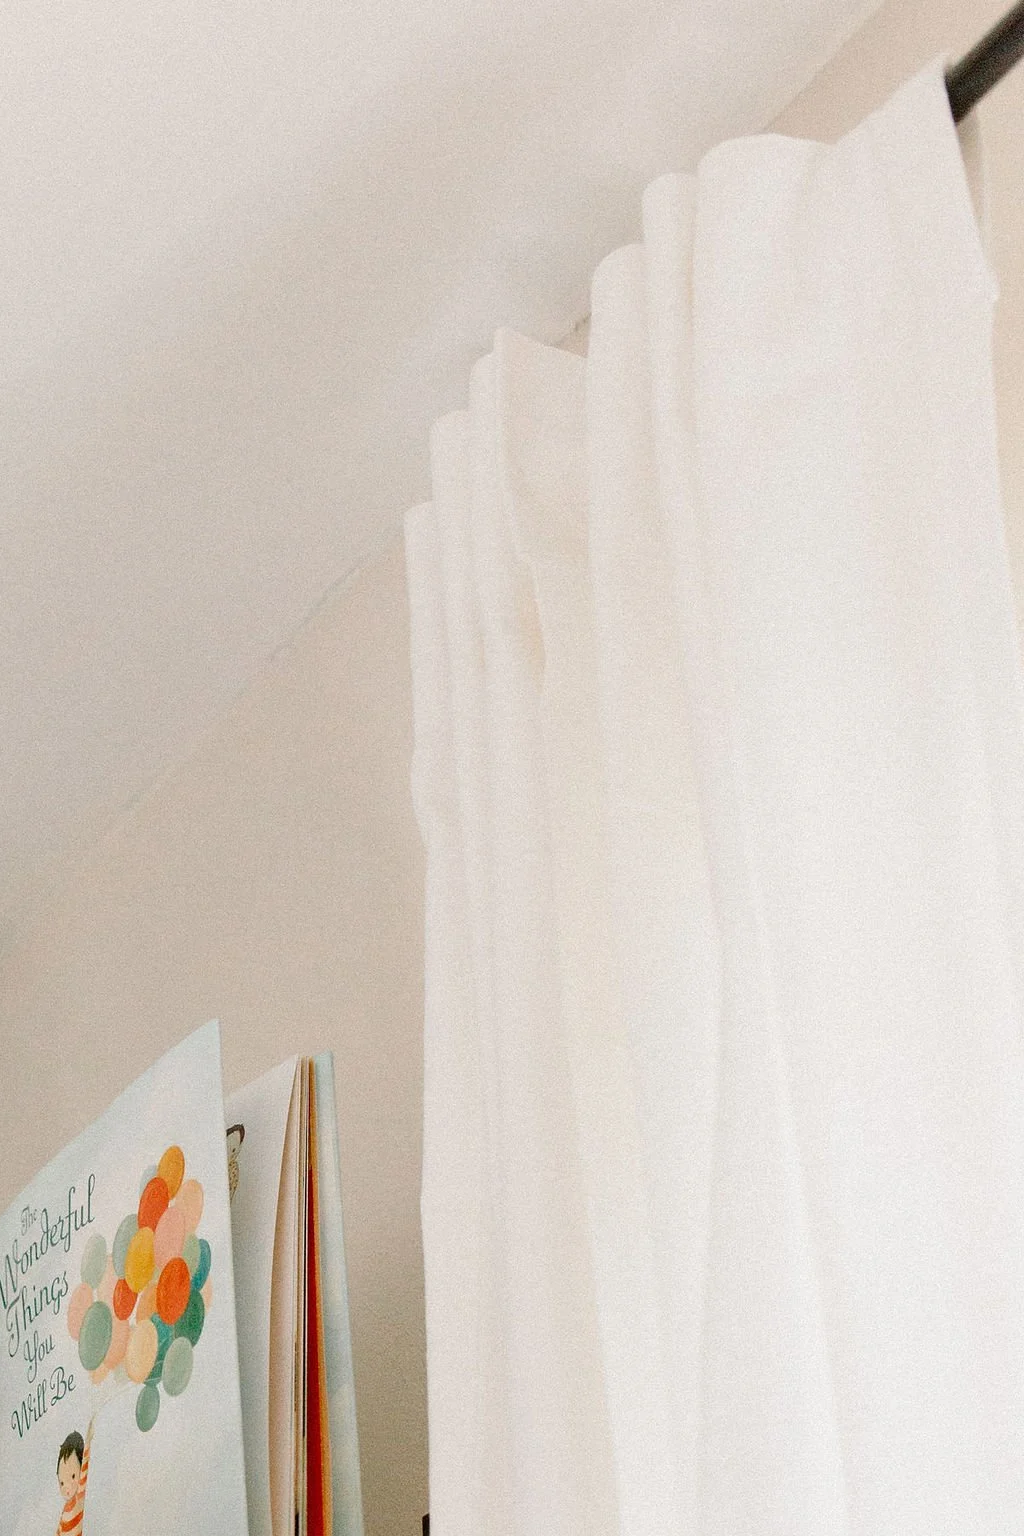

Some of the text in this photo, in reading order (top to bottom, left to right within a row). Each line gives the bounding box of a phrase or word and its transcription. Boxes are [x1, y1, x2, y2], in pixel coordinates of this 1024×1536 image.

[20, 1205, 38, 1236] The
[6, 1271, 70, 1357] Things
[23, 1331, 55, 1383] You
[11, 1366, 76, 1438] Will Be
